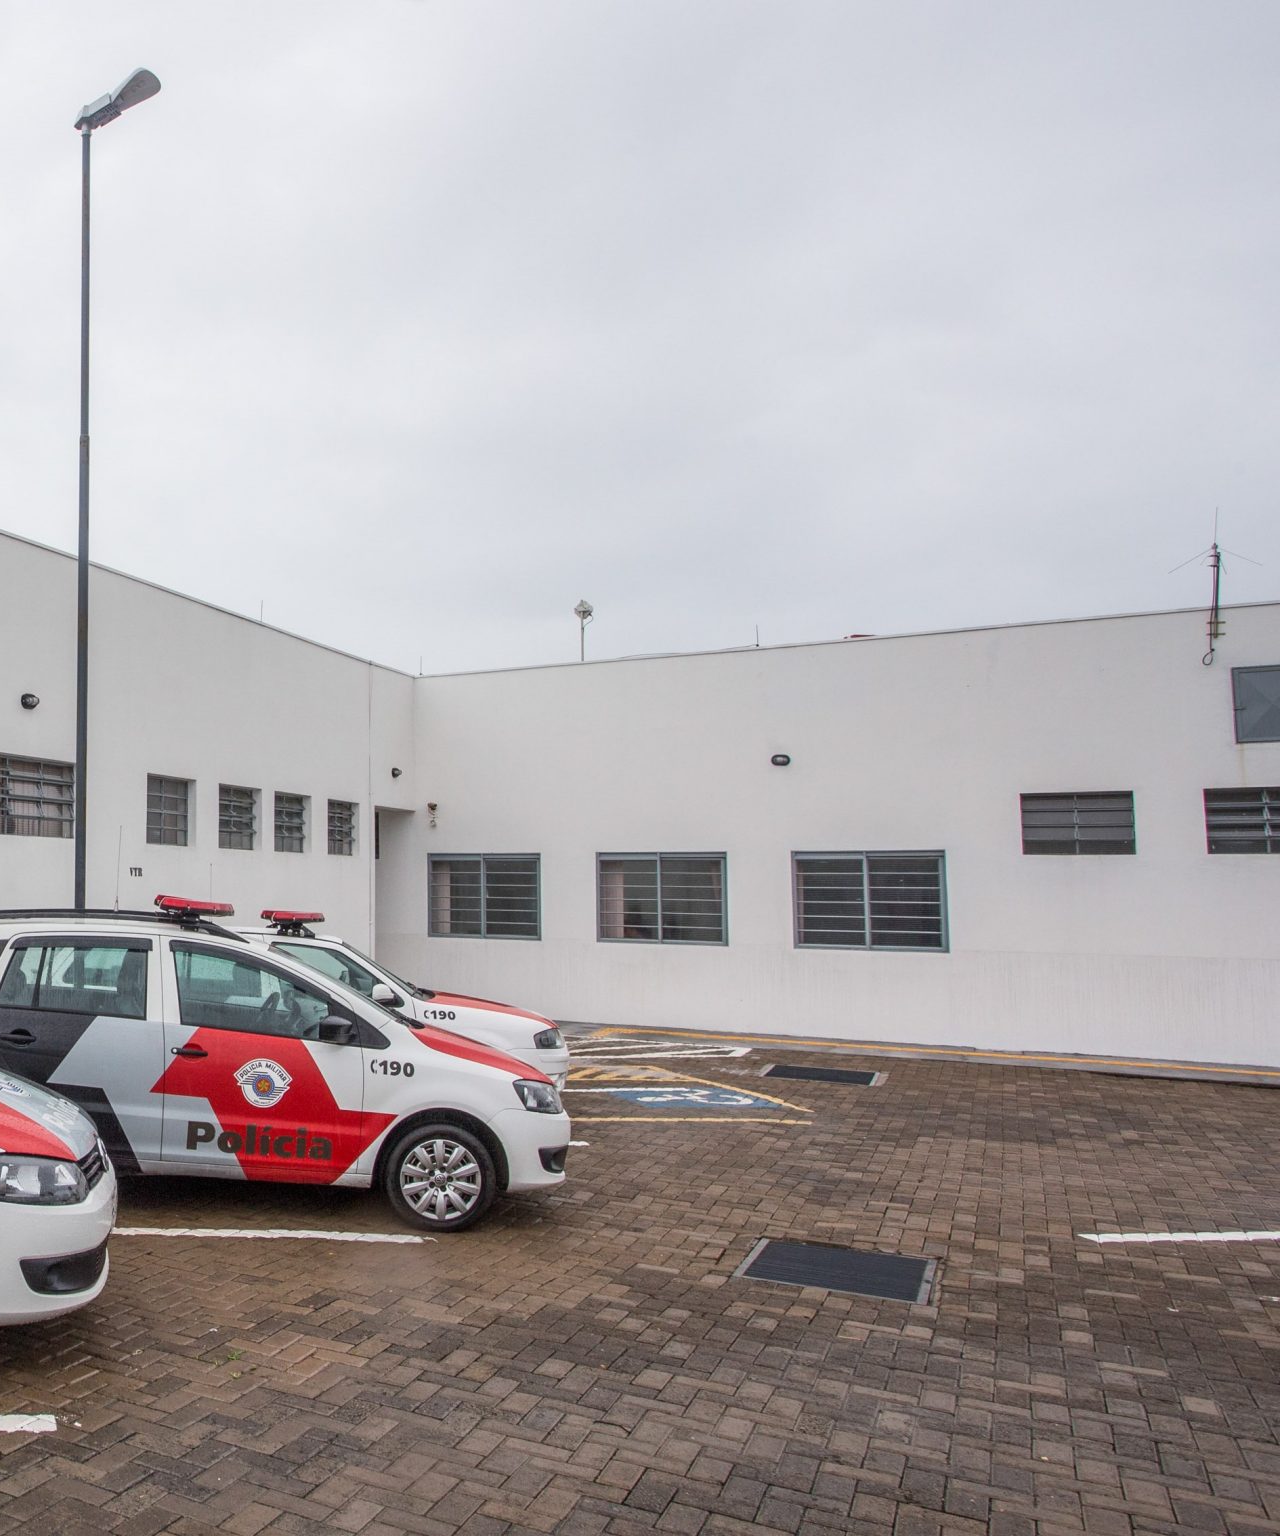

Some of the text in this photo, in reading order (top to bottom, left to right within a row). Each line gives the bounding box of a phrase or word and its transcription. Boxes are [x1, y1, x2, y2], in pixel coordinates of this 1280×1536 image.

[430, 1010, 456, 1020] 190
[239, 1062, 288, 1082] POLICIA MILITAR
[378, 1060, 415, 1077] 190
[186, 1120, 333, 1160] Polícia
